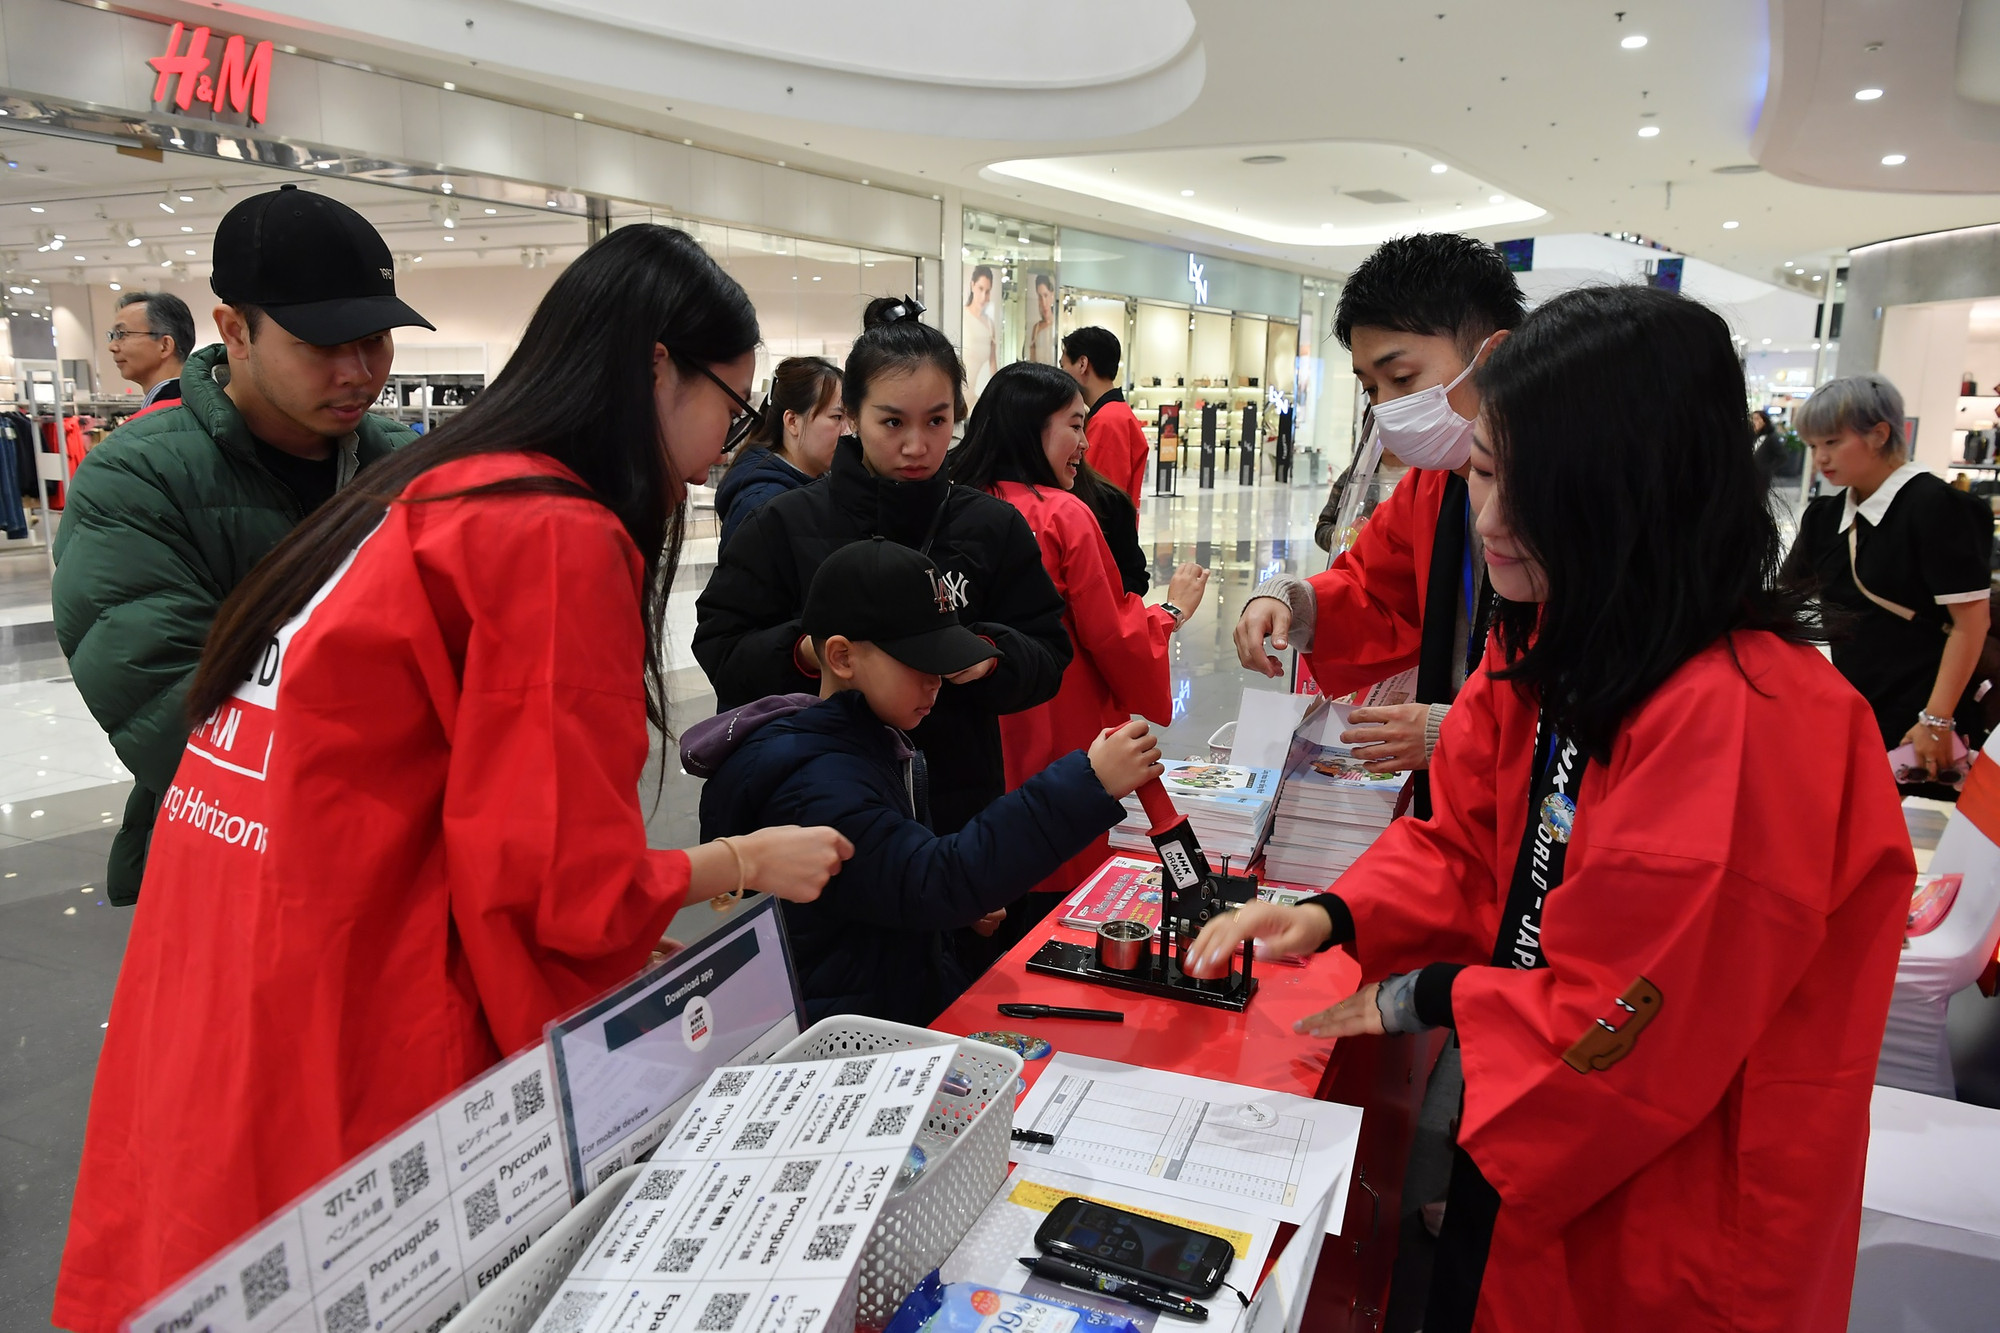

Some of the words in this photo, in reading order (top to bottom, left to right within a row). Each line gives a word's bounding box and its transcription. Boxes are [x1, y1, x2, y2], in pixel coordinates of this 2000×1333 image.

[149, 21, 274, 124] H&M
[1189, 253, 1208, 304] LYN
[942, 571, 969, 608] NY
[179, 787, 268, 854] Horizons
[1165, 851, 1184, 883] DRAMA
[1175, 852, 1192, 875] NHK
[1531, 817, 1553, 891] ORLD
[664, 974, 700, 1006] Download
[700, 968, 714, 985] app
[690, 1014, 704, 1027] NHK
[912, 1056, 941, 1096] English
[581, 1141, 597, 1156] For
[596, 1126, 622, 1148] mobile
[622, 1106, 649, 1130] devices
[817, 1095, 853, 1144] Indonesia
[838, 1093, 866, 1129] Bahasa
[499, 1133, 552, 1180] Русский
[630, 1133, 653, 1153] iPhone
[636, 1208, 666, 1238] Tiếng
[761, 1197, 807, 1264] Português
[369, 1218, 440, 1280] Português
[477, 1235, 531, 1289] Español
